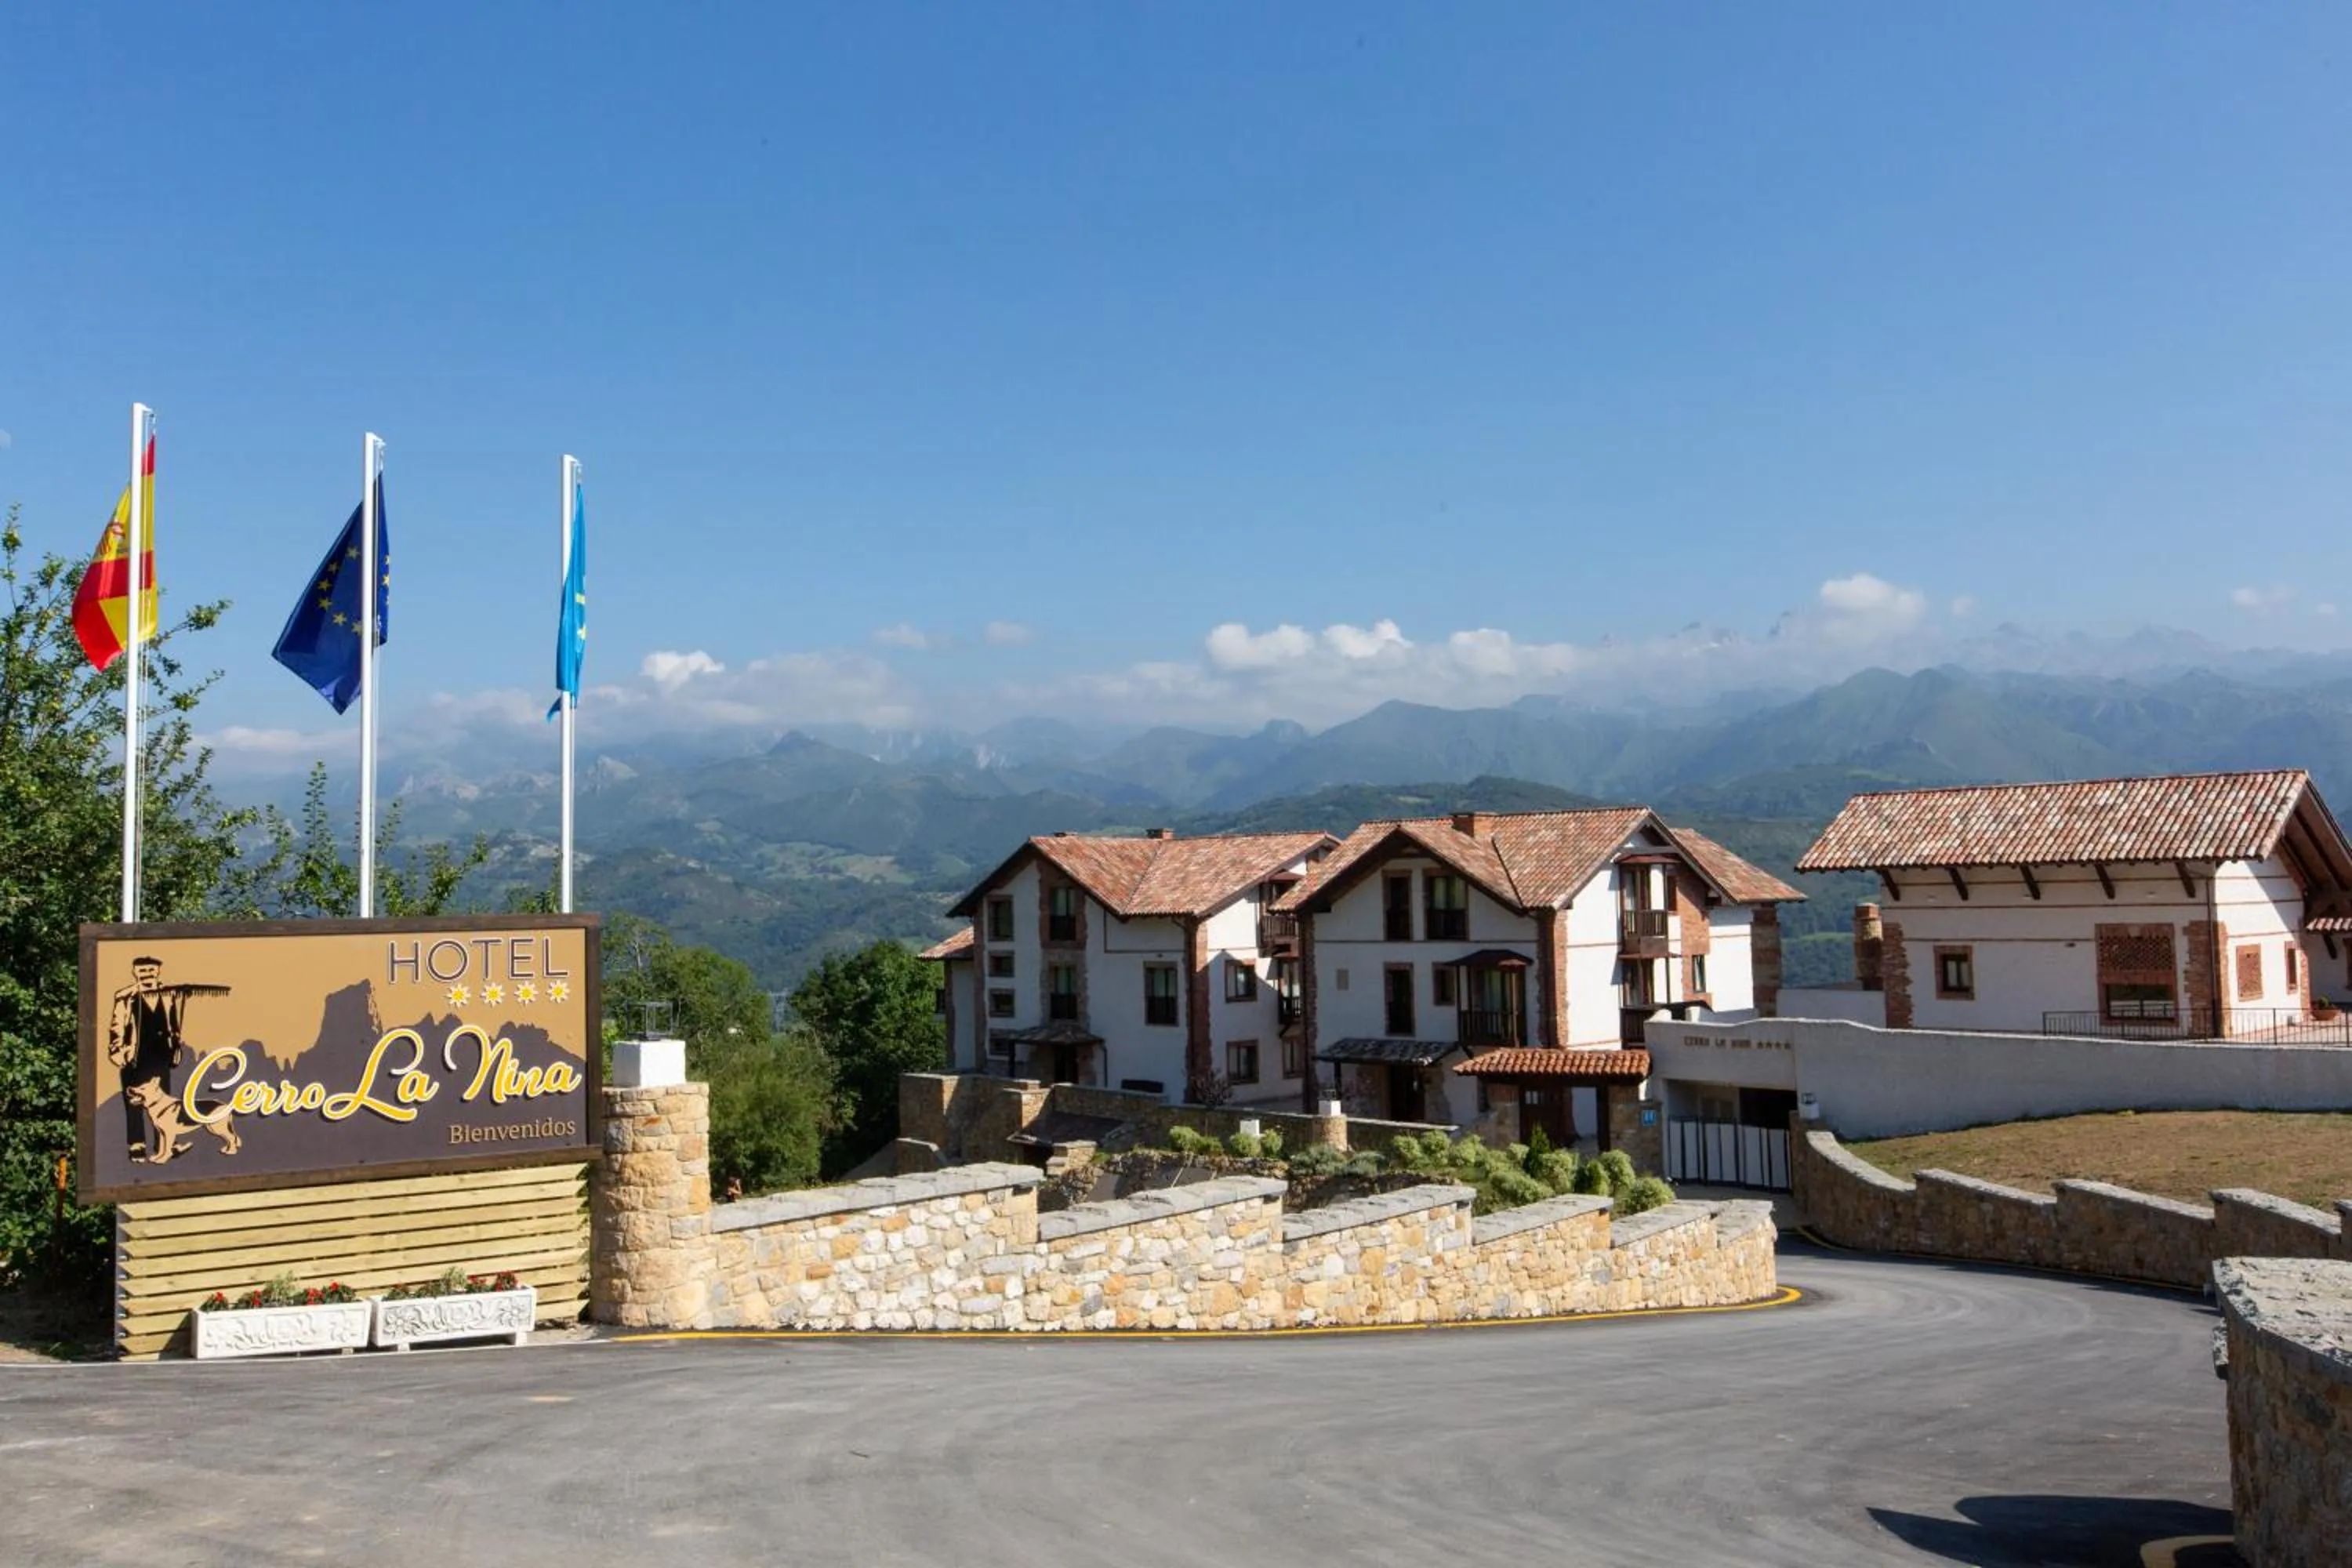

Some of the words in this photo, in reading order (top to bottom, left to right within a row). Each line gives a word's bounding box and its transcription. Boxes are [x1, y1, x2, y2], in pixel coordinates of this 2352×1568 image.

[388, 937, 569, 983] HOTEL
[182, 1047, 325, 1124] Cerro
[322, 1027, 440, 1121] La
[444, 1024, 583, 1104] Nina
[449, 1116, 576, 1145] Bienvenidos
